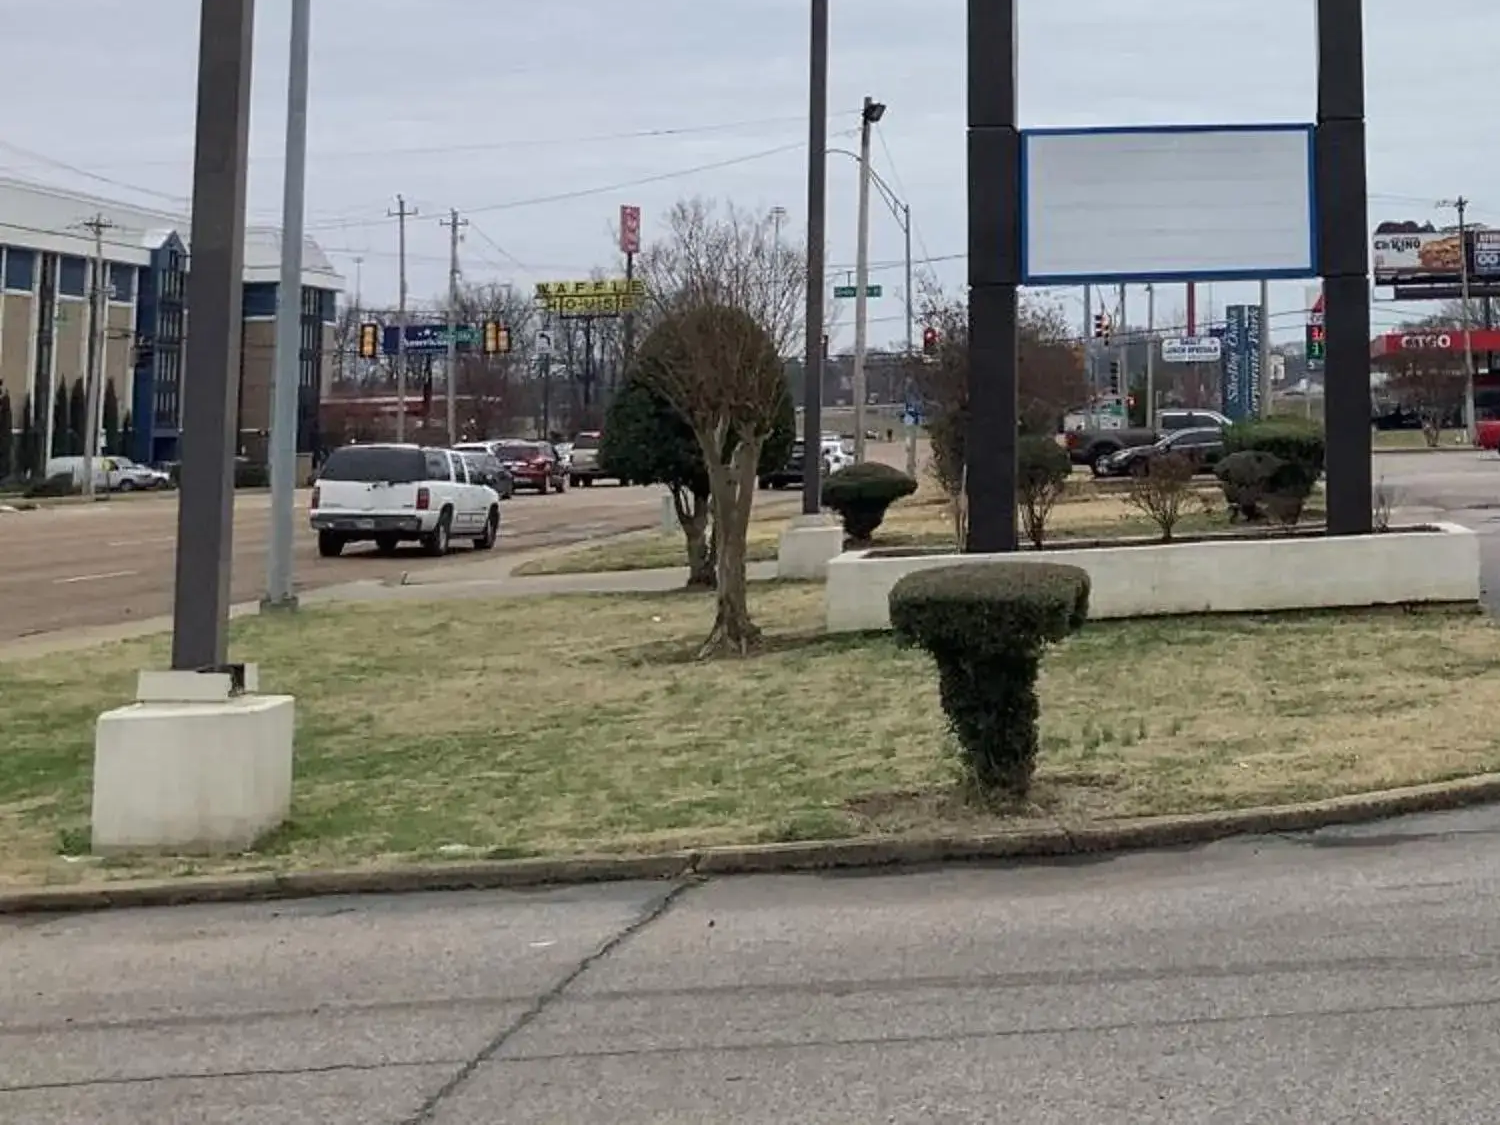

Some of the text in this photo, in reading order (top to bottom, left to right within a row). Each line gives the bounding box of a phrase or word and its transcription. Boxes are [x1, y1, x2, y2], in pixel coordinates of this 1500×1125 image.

[536, 280, 643, 295] WAFFLE
[547, 297, 634, 311] HOUSE
[1248, 309, 1259, 344] Park
[1401, 334, 1451, 348] CITGO
[1227, 352, 1242, 402] Shelby
